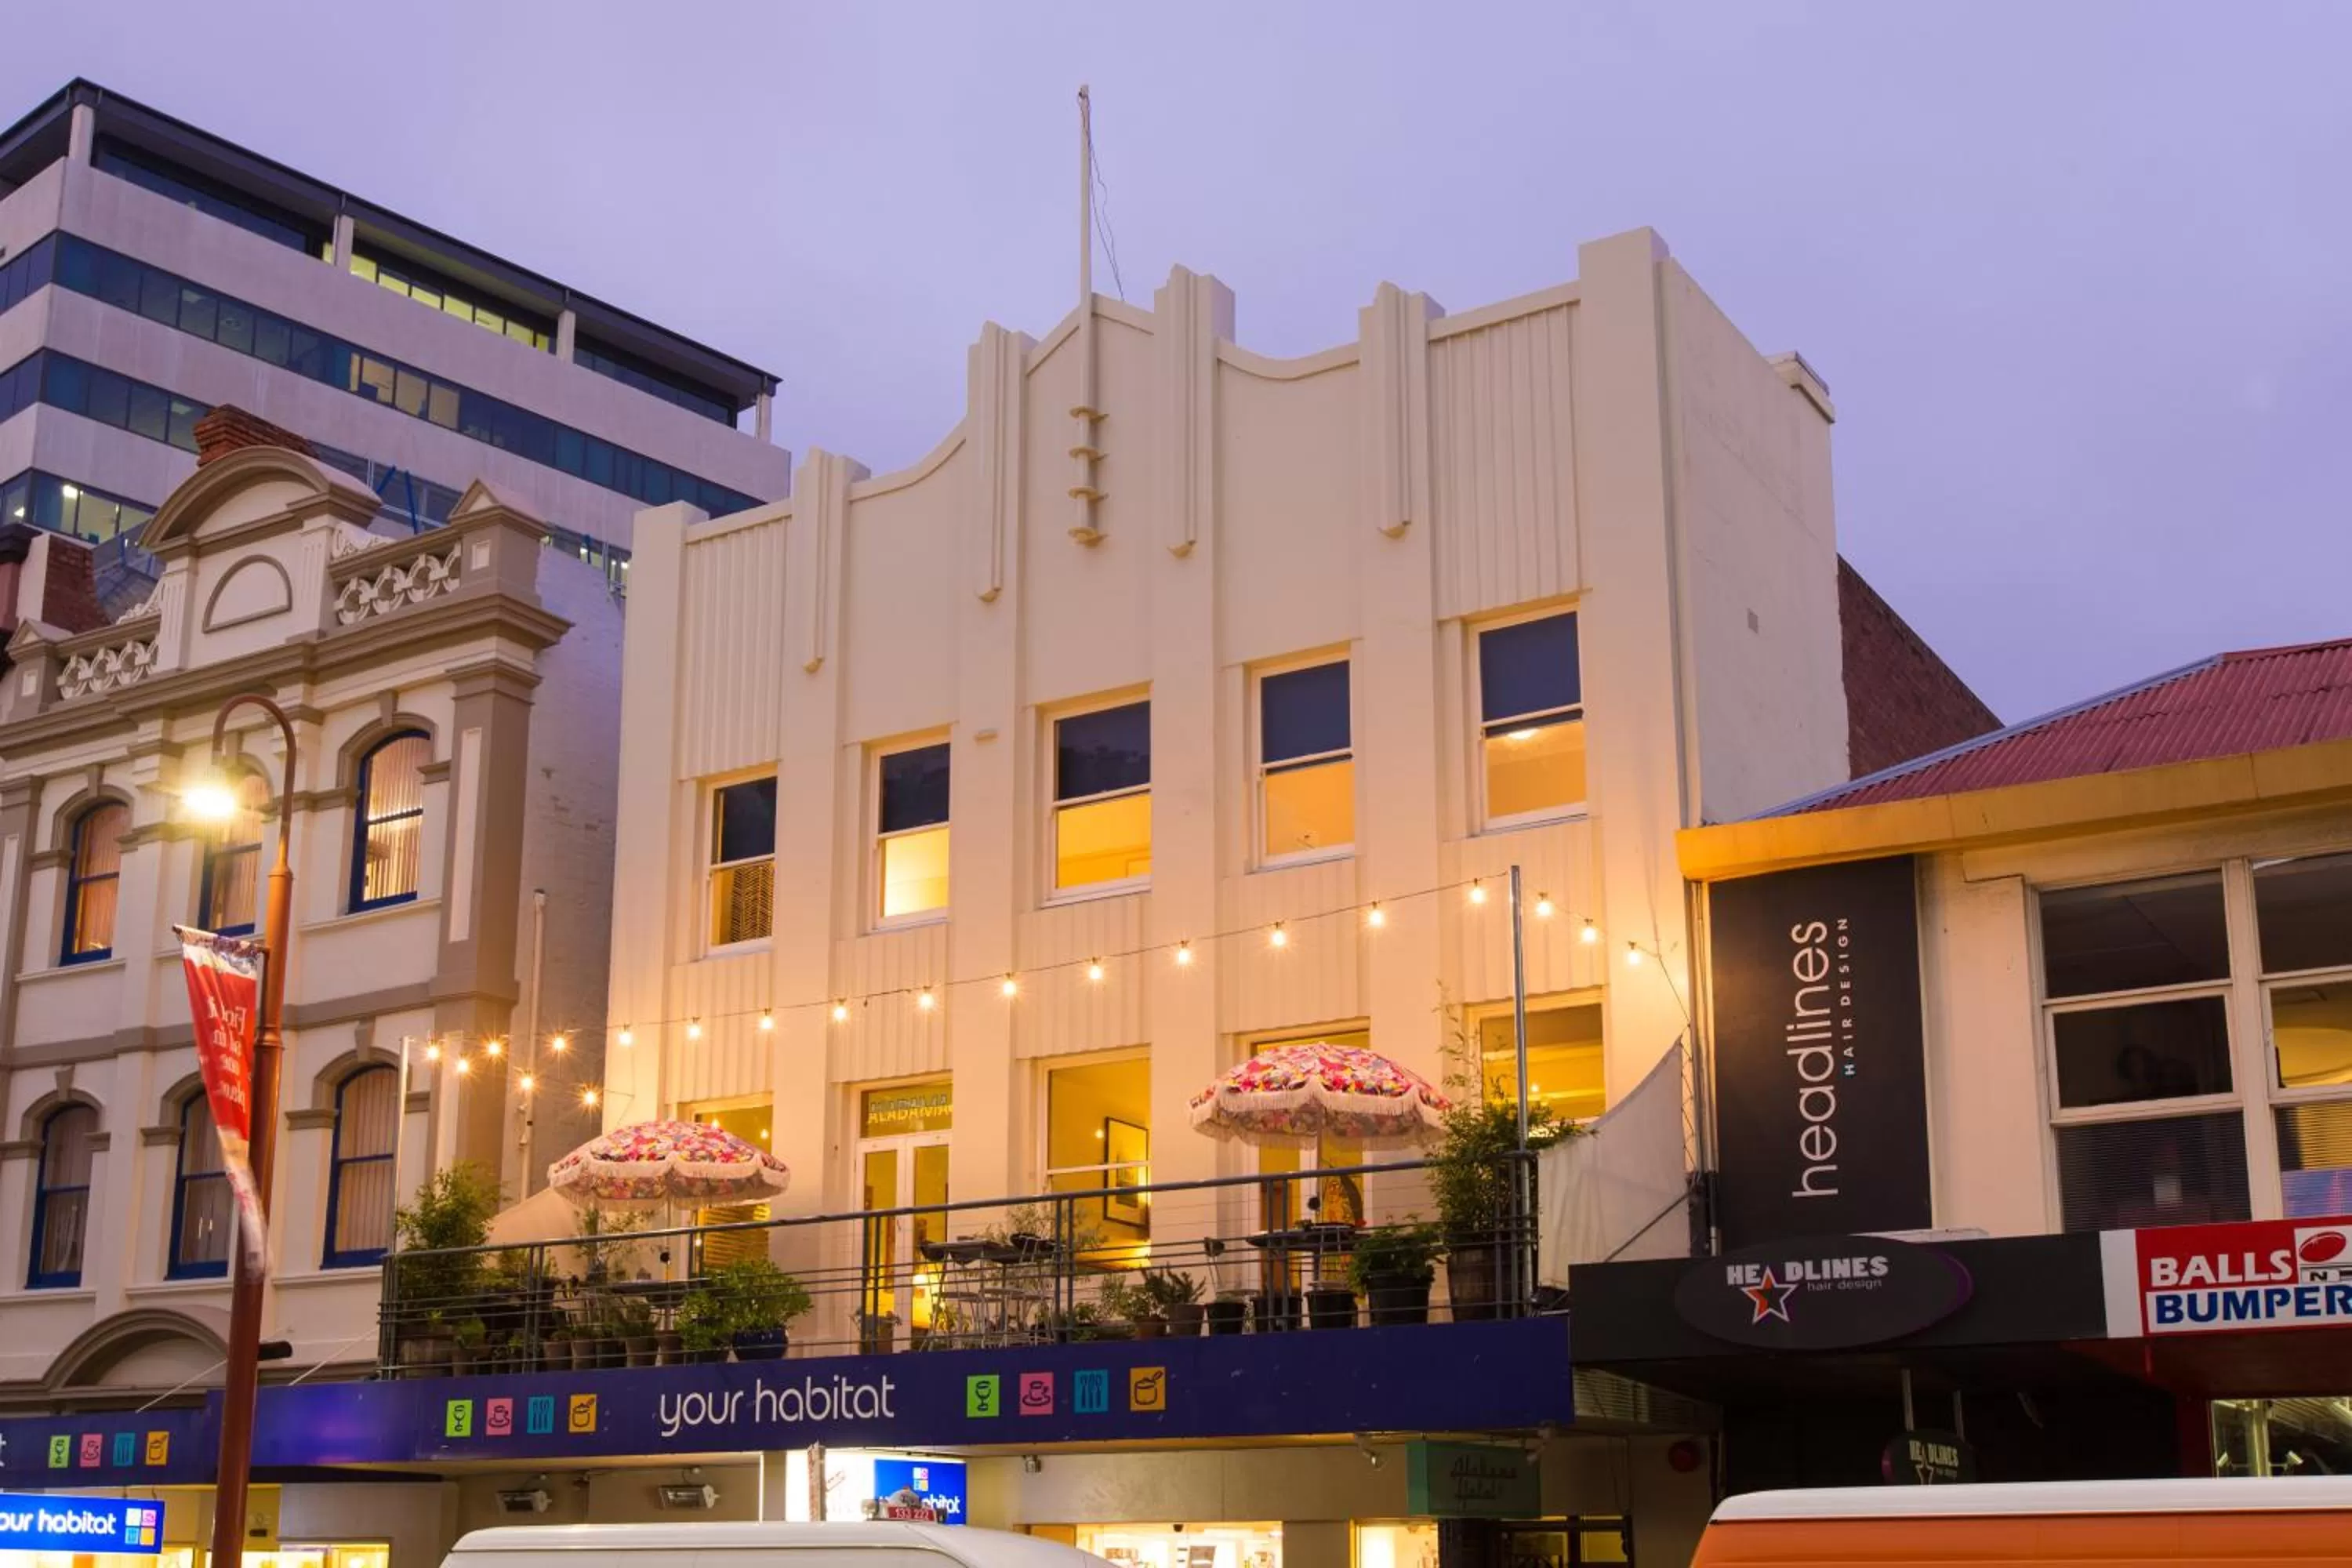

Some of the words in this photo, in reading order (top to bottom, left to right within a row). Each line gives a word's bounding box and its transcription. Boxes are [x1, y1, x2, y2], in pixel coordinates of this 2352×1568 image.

[1837, 918, 1852, 1007] DESIGN
[1787, 920, 1838, 1198] headlines
[1842, 1018, 1857, 1076] HAIR
[1806, 1281, 1833, 1292] hair
[1837, 1278, 1882, 1290] design
[2150, 1249, 2293, 1287] BALLS
[2155, 1284, 2352, 1324] BUMPER
[659, 1390, 744, 1437] your
[755, 1374, 895, 1423] habitat
[38, 1508, 117, 1534] habitat
[895, 1507, 912, 1519] 133
[920, 1494, 960, 1514] abitat
